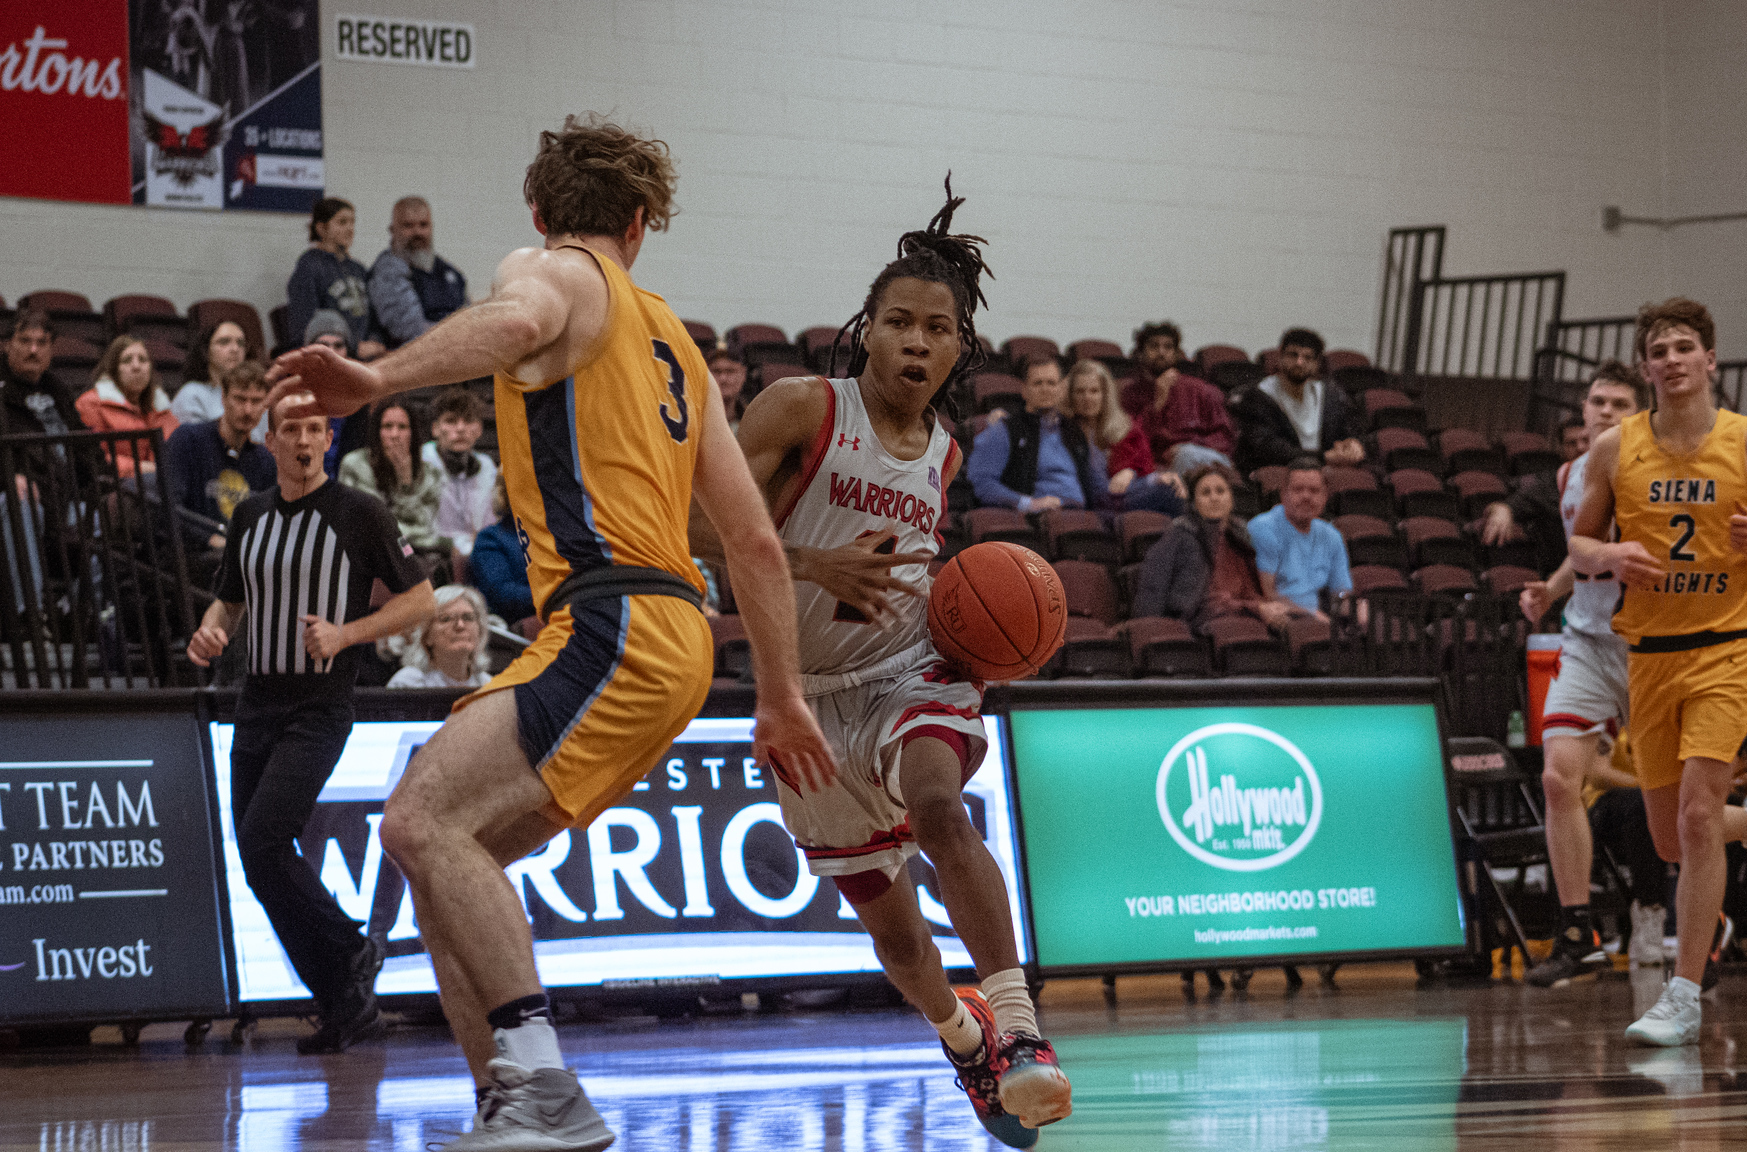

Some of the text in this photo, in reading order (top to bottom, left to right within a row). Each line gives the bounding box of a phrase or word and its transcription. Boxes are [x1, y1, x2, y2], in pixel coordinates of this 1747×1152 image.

[337, 19, 472, 64] RESERVED
[650, 336, 690, 446] 3
[828, 472, 936, 535] WARRIORS
[1649, 479, 1716, 503] SIENA
[1669, 514, 1696, 562] 2
[24, 779, 160, 830] TEAM
[1182, 745, 1307, 844] Hollywood
[12, 837, 165, 871] PARTNERS
[1124, 886, 1377, 917] YOUR NEIGHBORHOOD STORE!
[1194, 925, 1318, 944] hollywoodmarkets.com
[32, 937, 154, 982] Invest
